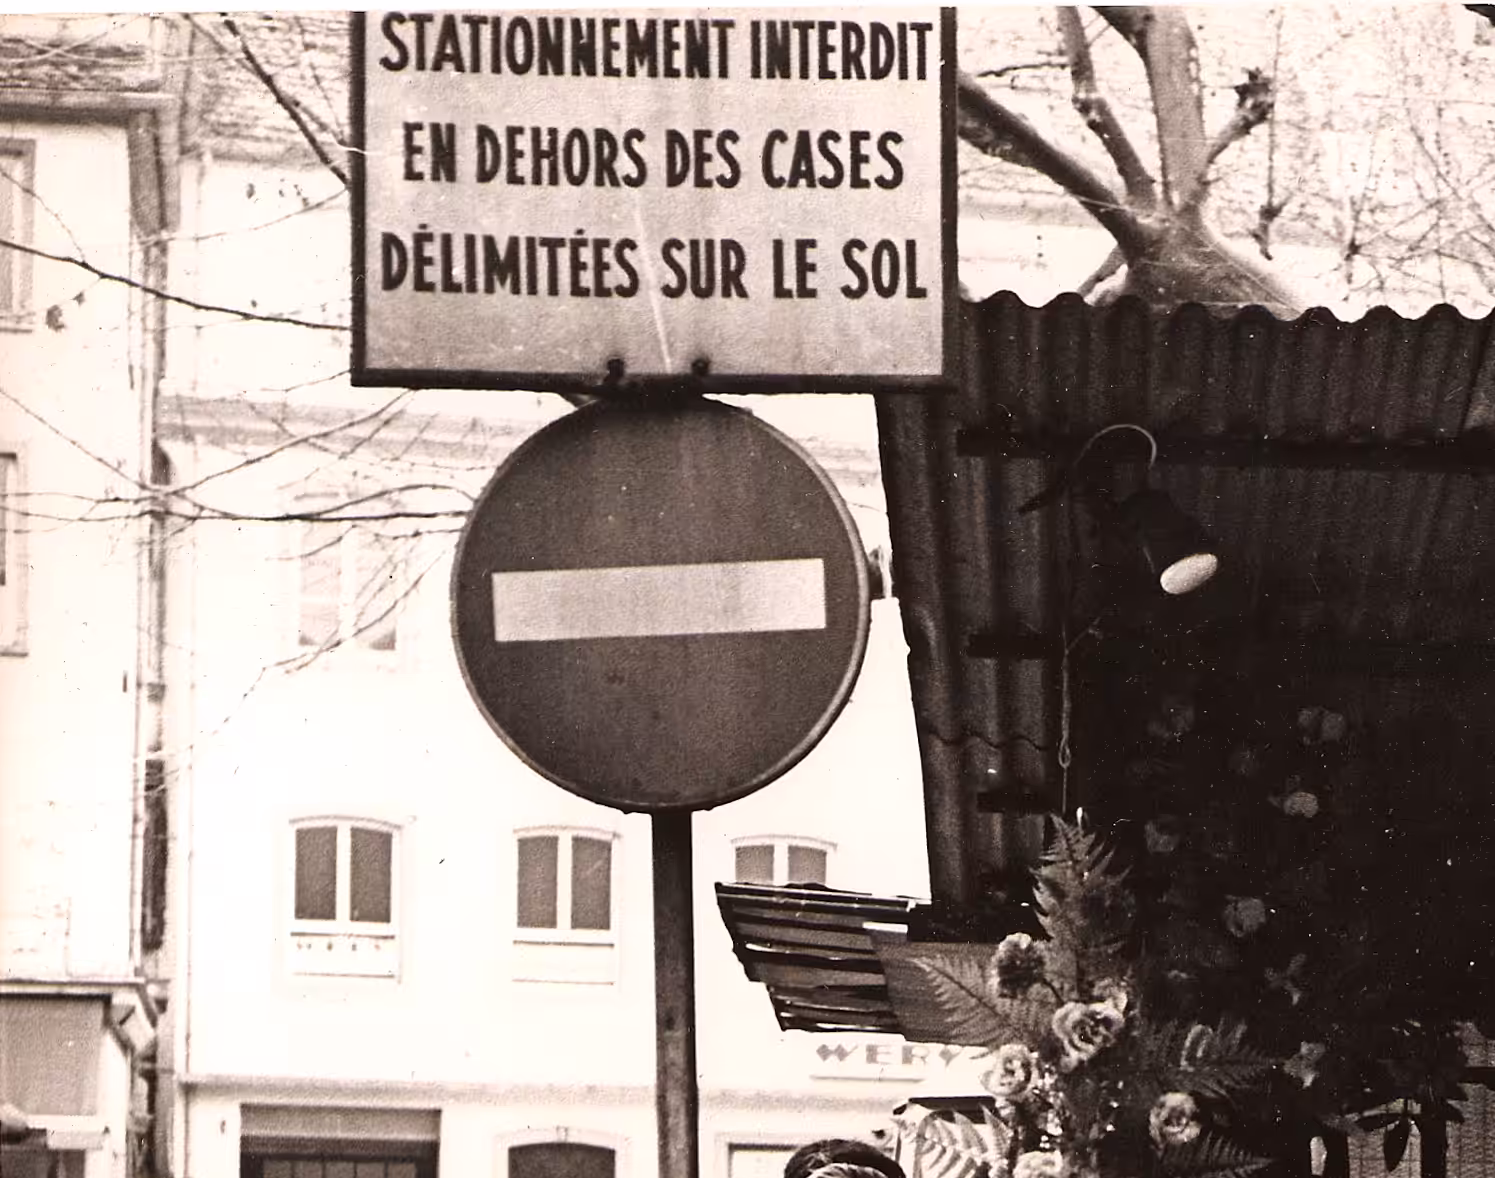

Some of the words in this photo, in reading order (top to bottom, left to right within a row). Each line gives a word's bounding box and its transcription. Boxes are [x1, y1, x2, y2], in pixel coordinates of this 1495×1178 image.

[379, 12, 735, 79] STATIONNEMENT
[750, 20, 933, 80] INTERDIT
[403, 122, 457, 183] EN
[475, 124, 648, 188] DEHORS
[665, 129, 741, 189] DES
[761, 129, 904, 190] CASES
[381, 224, 638, 298] DÉLIMITÉES
[661, 238, 748, 299] SUR
[772, 238, 818, 298] LE
[840, 238, 928, 299] SOL
[815, 1043, 963, 1069] WERY
